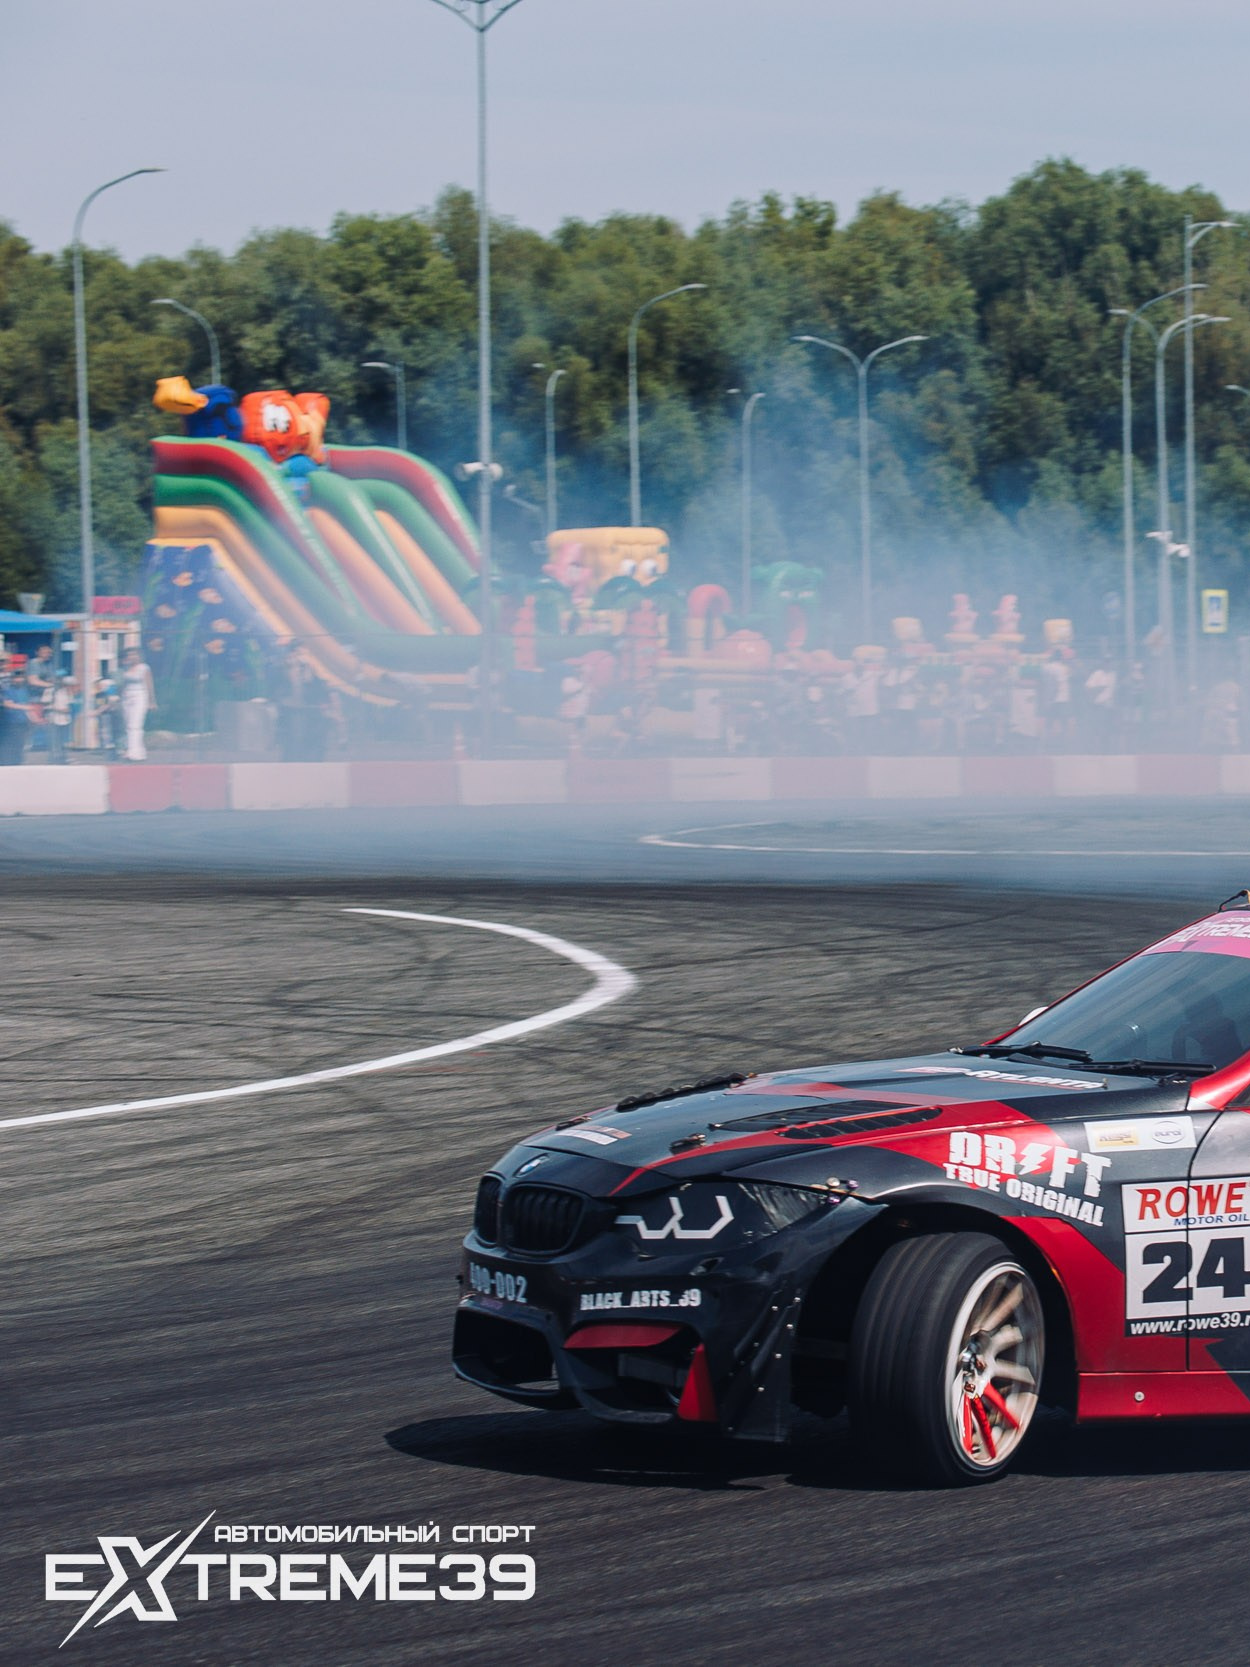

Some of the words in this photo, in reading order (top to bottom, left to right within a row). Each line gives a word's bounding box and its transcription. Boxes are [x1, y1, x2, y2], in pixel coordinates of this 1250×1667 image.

[1005, 1178, 1105, 1227] ORIGINAL
[1136, 1182, 1247, 1221] ROWE
[1173, 1214, 1224, 1226] MOTOR
[1227, 1213, 1250, 1223] OIL
